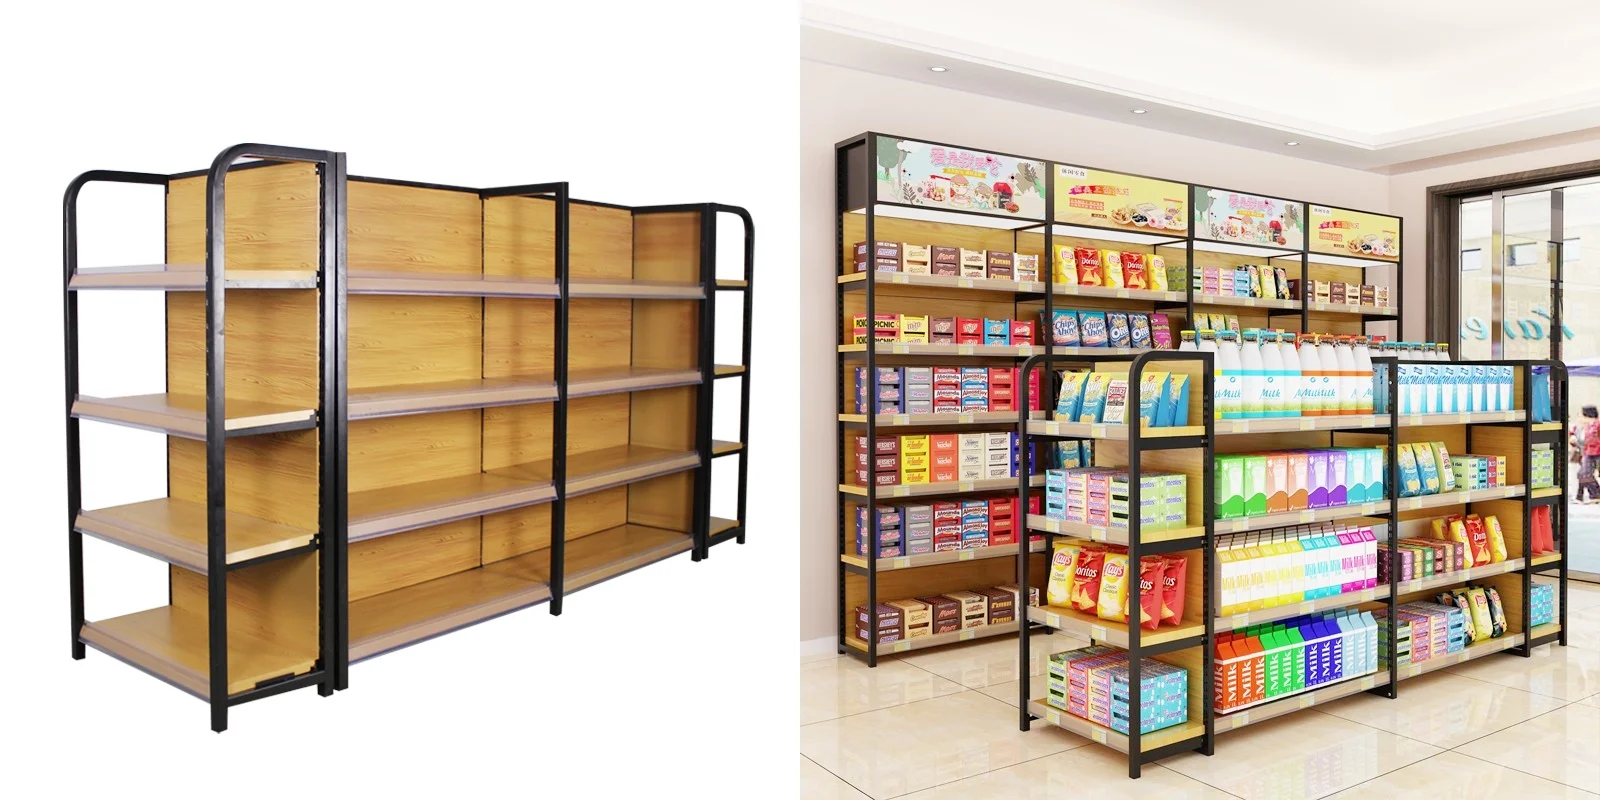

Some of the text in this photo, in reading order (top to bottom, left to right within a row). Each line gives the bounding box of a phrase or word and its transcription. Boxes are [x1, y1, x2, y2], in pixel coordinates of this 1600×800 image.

[1260, 388, 1280, 399] Milk
[1342, 557, 1353, 569] Milk
[1354, 555, 1364, 567] Milk
[1256, 656, 1264, 694] Milk
[1270, 653, 1278, 691] Milk
[1283, 650, 1292, 688] Milk
[1322, 641, 1330, 677] Milk
[1228, 663, 1236, 702] Milk
[1242, 660, 1251, 698] Milk
